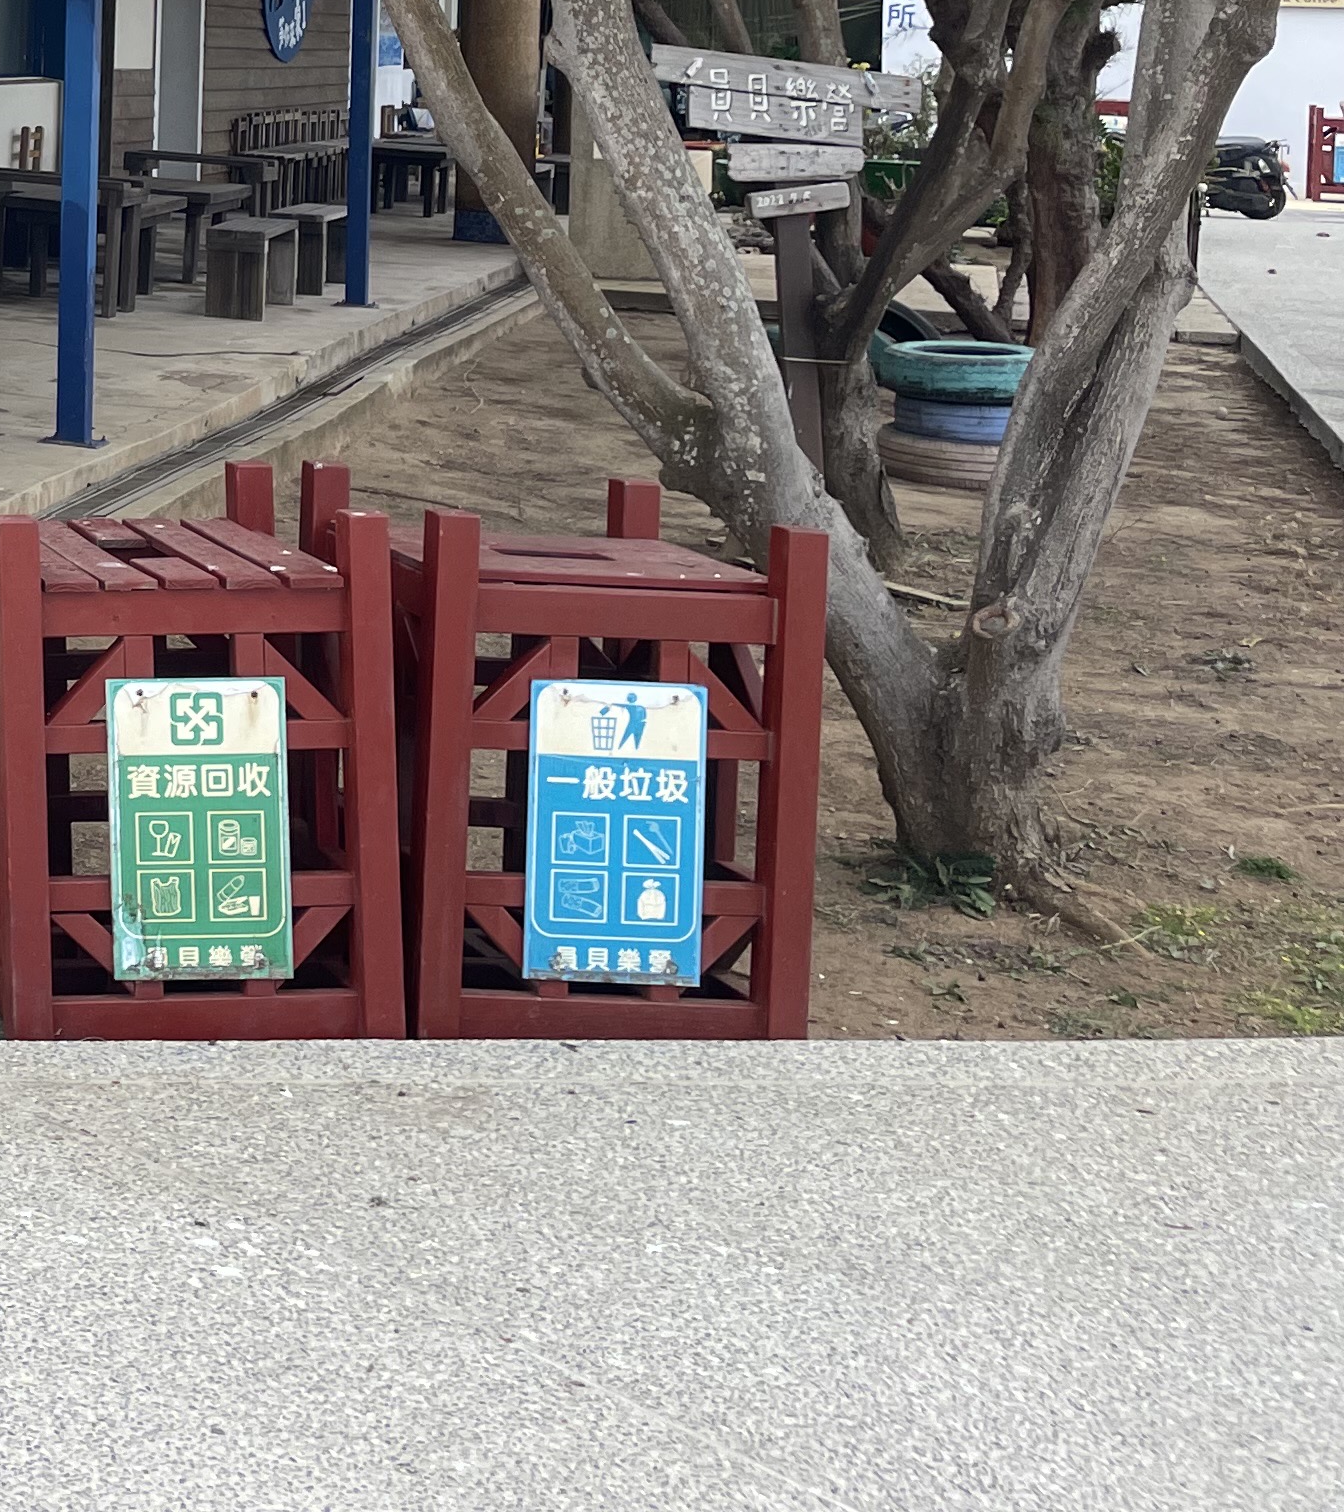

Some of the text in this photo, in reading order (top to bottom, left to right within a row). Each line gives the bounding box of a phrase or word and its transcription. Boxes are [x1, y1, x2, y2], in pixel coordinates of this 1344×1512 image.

[127, 763, 271, 798] 資源回收
[547, 765, 689, 803] 一般垃圾
